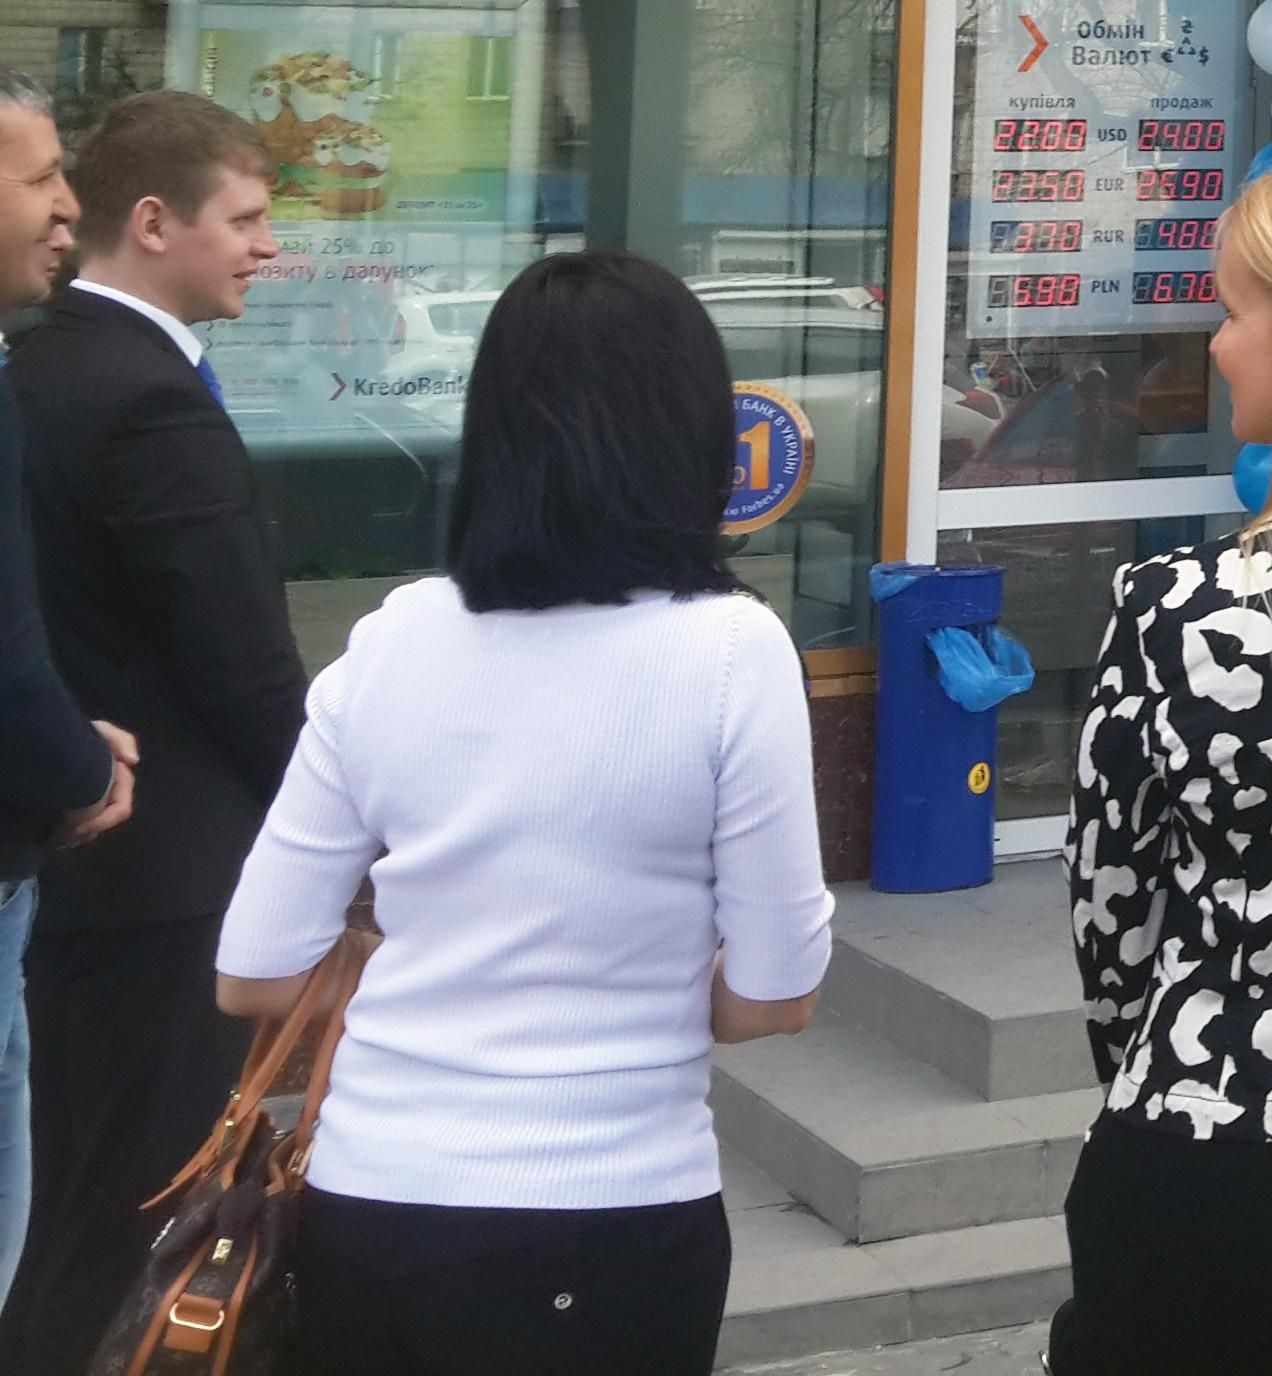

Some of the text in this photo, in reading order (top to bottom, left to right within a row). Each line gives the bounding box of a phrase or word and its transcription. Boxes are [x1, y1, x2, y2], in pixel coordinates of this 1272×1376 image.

[1077, 20, 1145, 40] Обмін
[1072, 45, 1152, 66] Валют
[1008, 94, 1215, 112] купівля продаж
[1097, 128, 1128, 142] USD
[1095, 178, 1125, 192] EUR
[1093, 229, 1126, 244] RUR
[1091, 280, 1121, 293] PLN
[742, 398, 801, 475] БАНК В УКРАЇНІ
